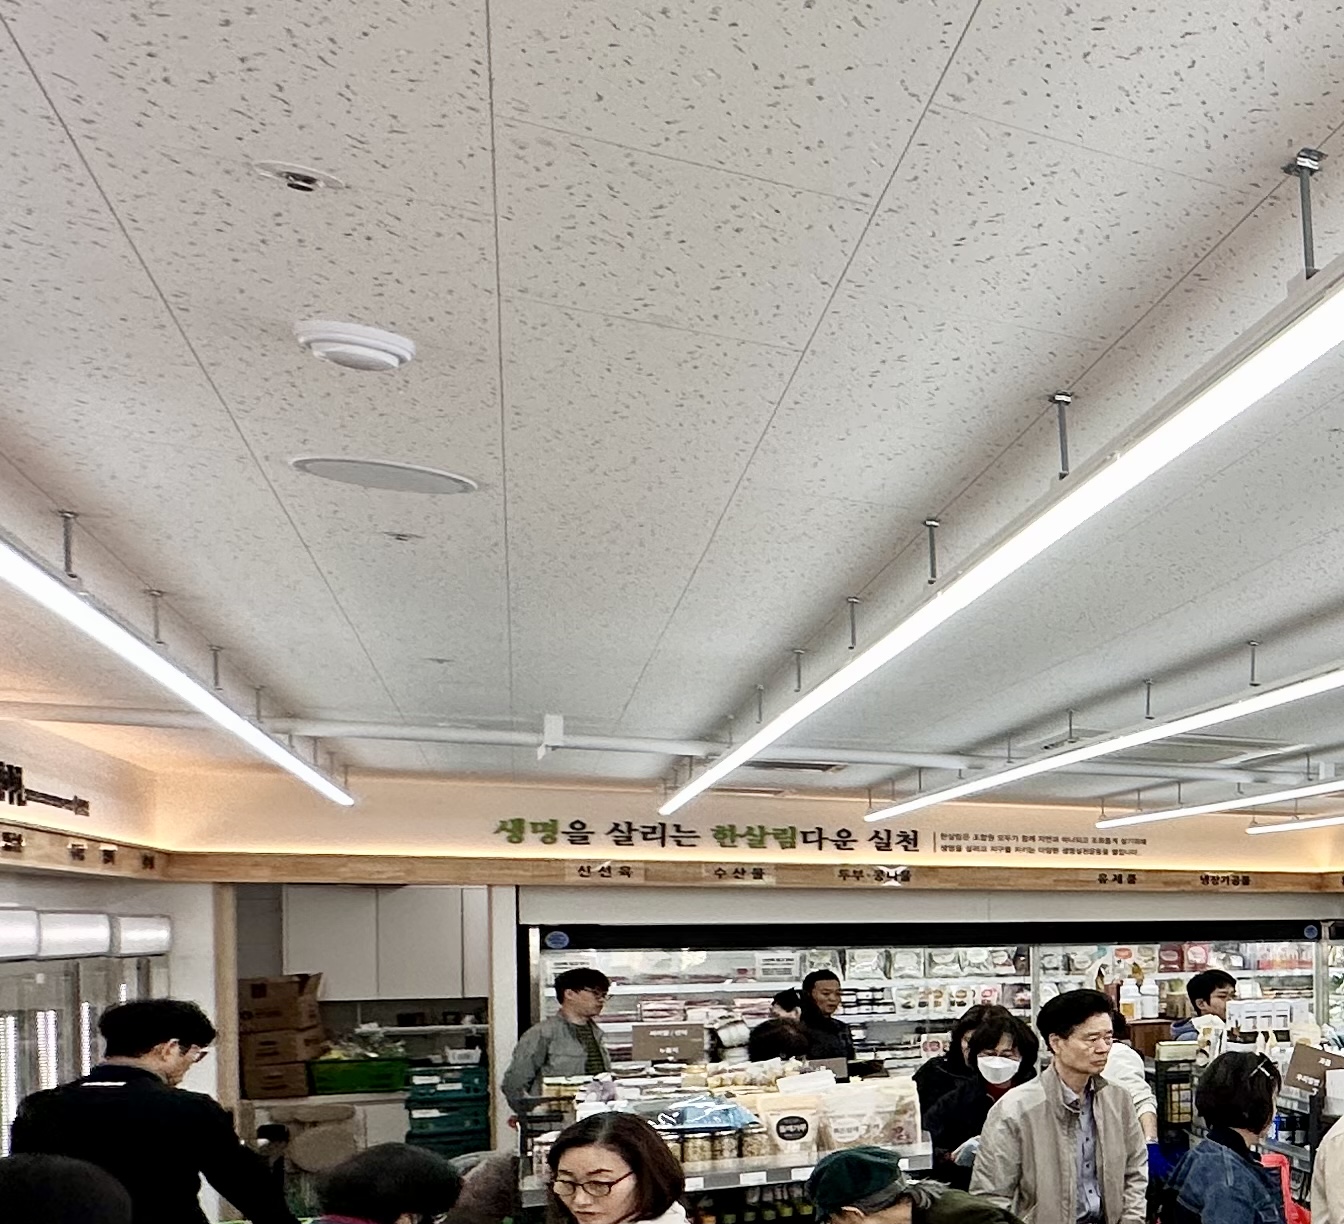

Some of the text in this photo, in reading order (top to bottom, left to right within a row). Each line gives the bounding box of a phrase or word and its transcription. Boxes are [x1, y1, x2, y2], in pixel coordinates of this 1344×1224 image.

[493, 818, 920, 853] 생명을 살리는 한살림다운 실천
[713, 866, 766, 881] 수산물
[1097, 873, 1138, 885] 유제품
